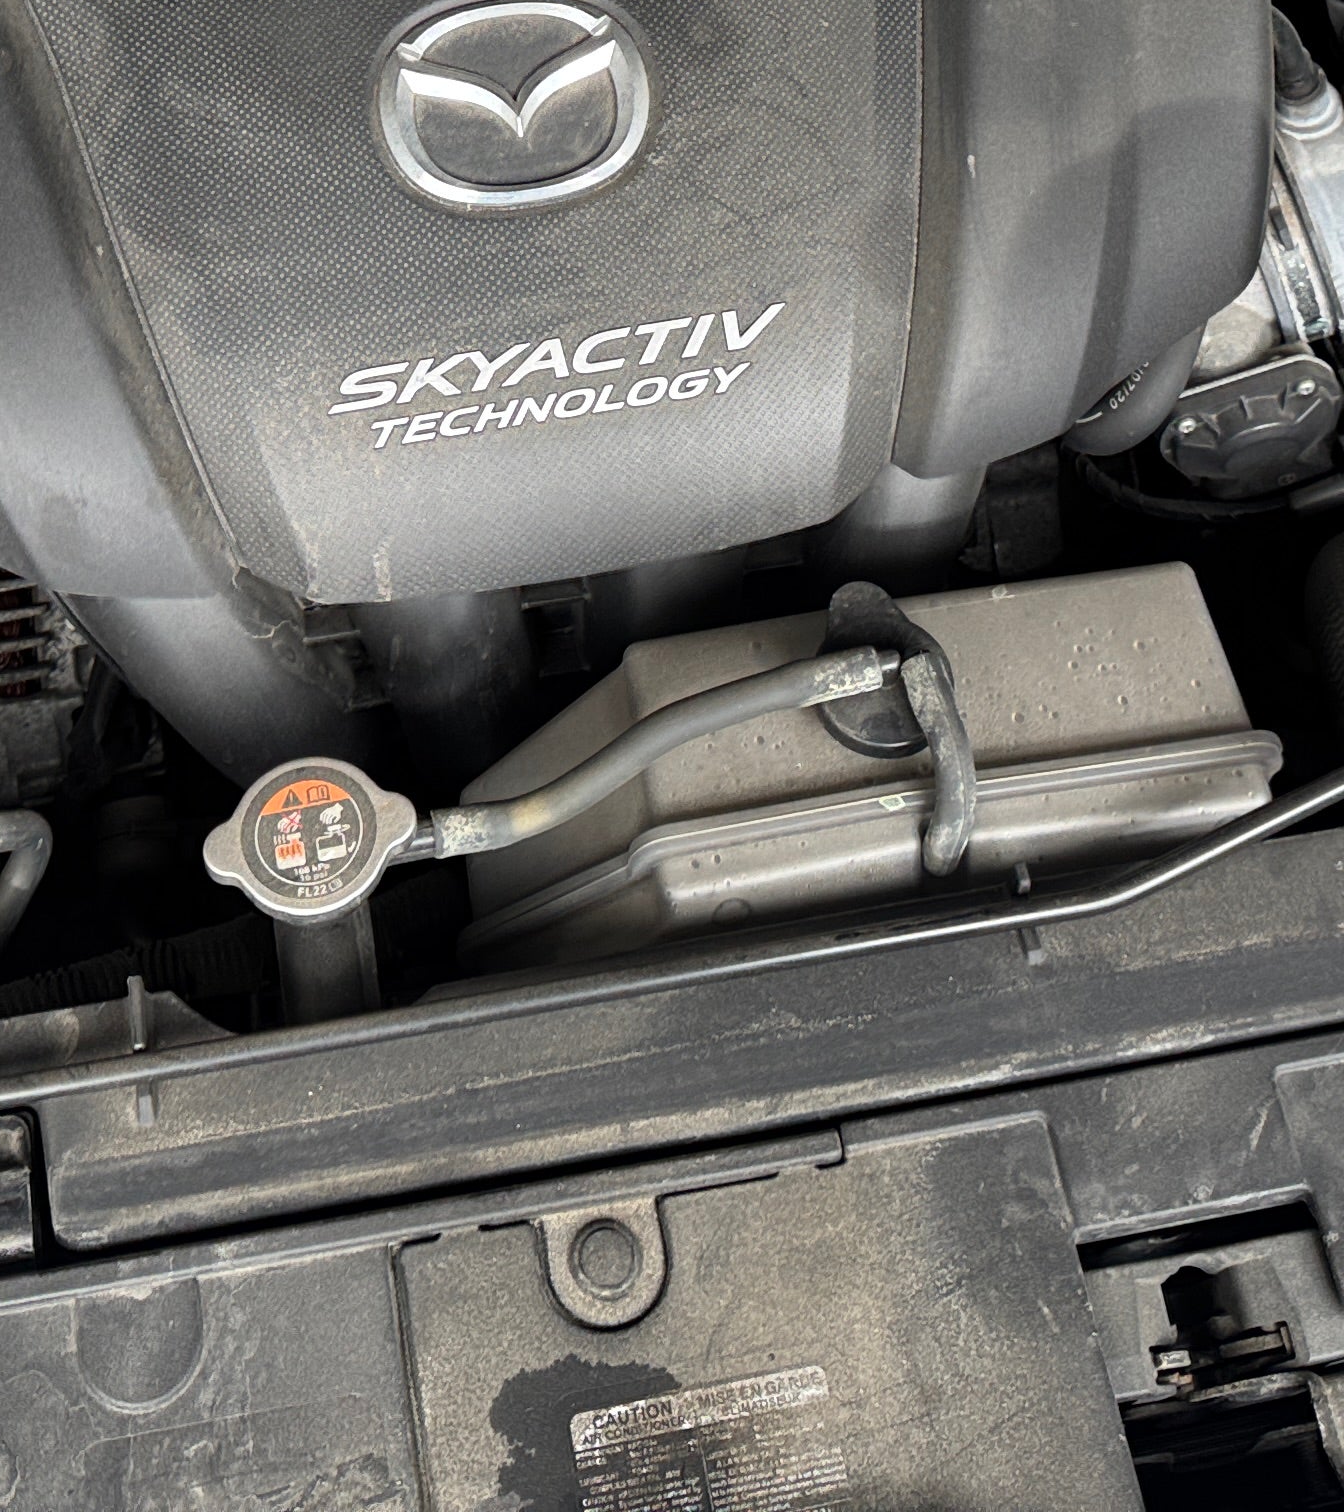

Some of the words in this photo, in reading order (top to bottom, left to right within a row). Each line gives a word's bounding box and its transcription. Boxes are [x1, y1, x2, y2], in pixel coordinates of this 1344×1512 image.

[328, 302, 786, 416] SKYACTIV
[370, 362, 752, 450] TECHNOLOGY
[298, 885, 327, 897] FL22
[313, 870, 329, 881] psi
[592, 1399, 673, 1429] CAUTION
[696, 1387, 736, 1408] MISE
[739, 1382, 761, 1400] EN
[581, 1433, 603, 1446] AIR
[604, 1415, 686, 1441] CONDITIONER
